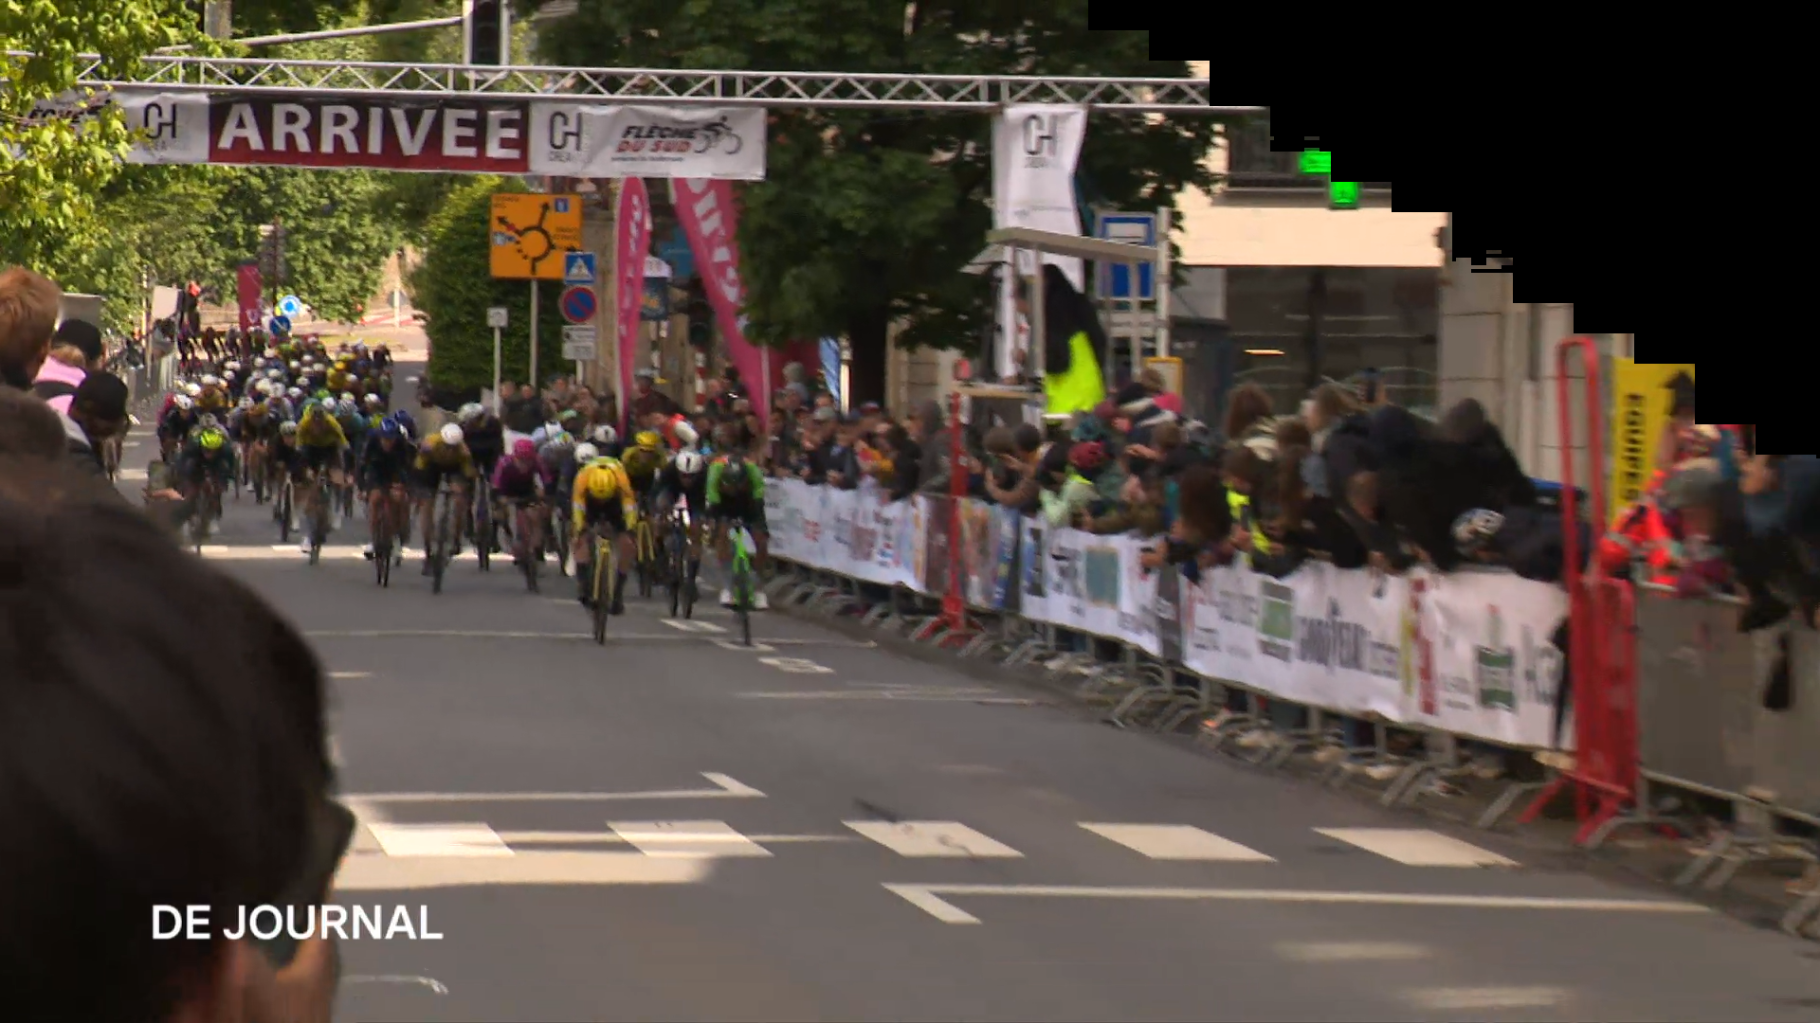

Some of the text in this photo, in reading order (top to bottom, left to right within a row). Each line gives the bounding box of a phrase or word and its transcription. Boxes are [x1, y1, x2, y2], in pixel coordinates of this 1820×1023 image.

[217, 102, 522, 160] ARRIVEE
[549, 110, 582, 151] CH
[616, 140, 693, 154] DU SUD
